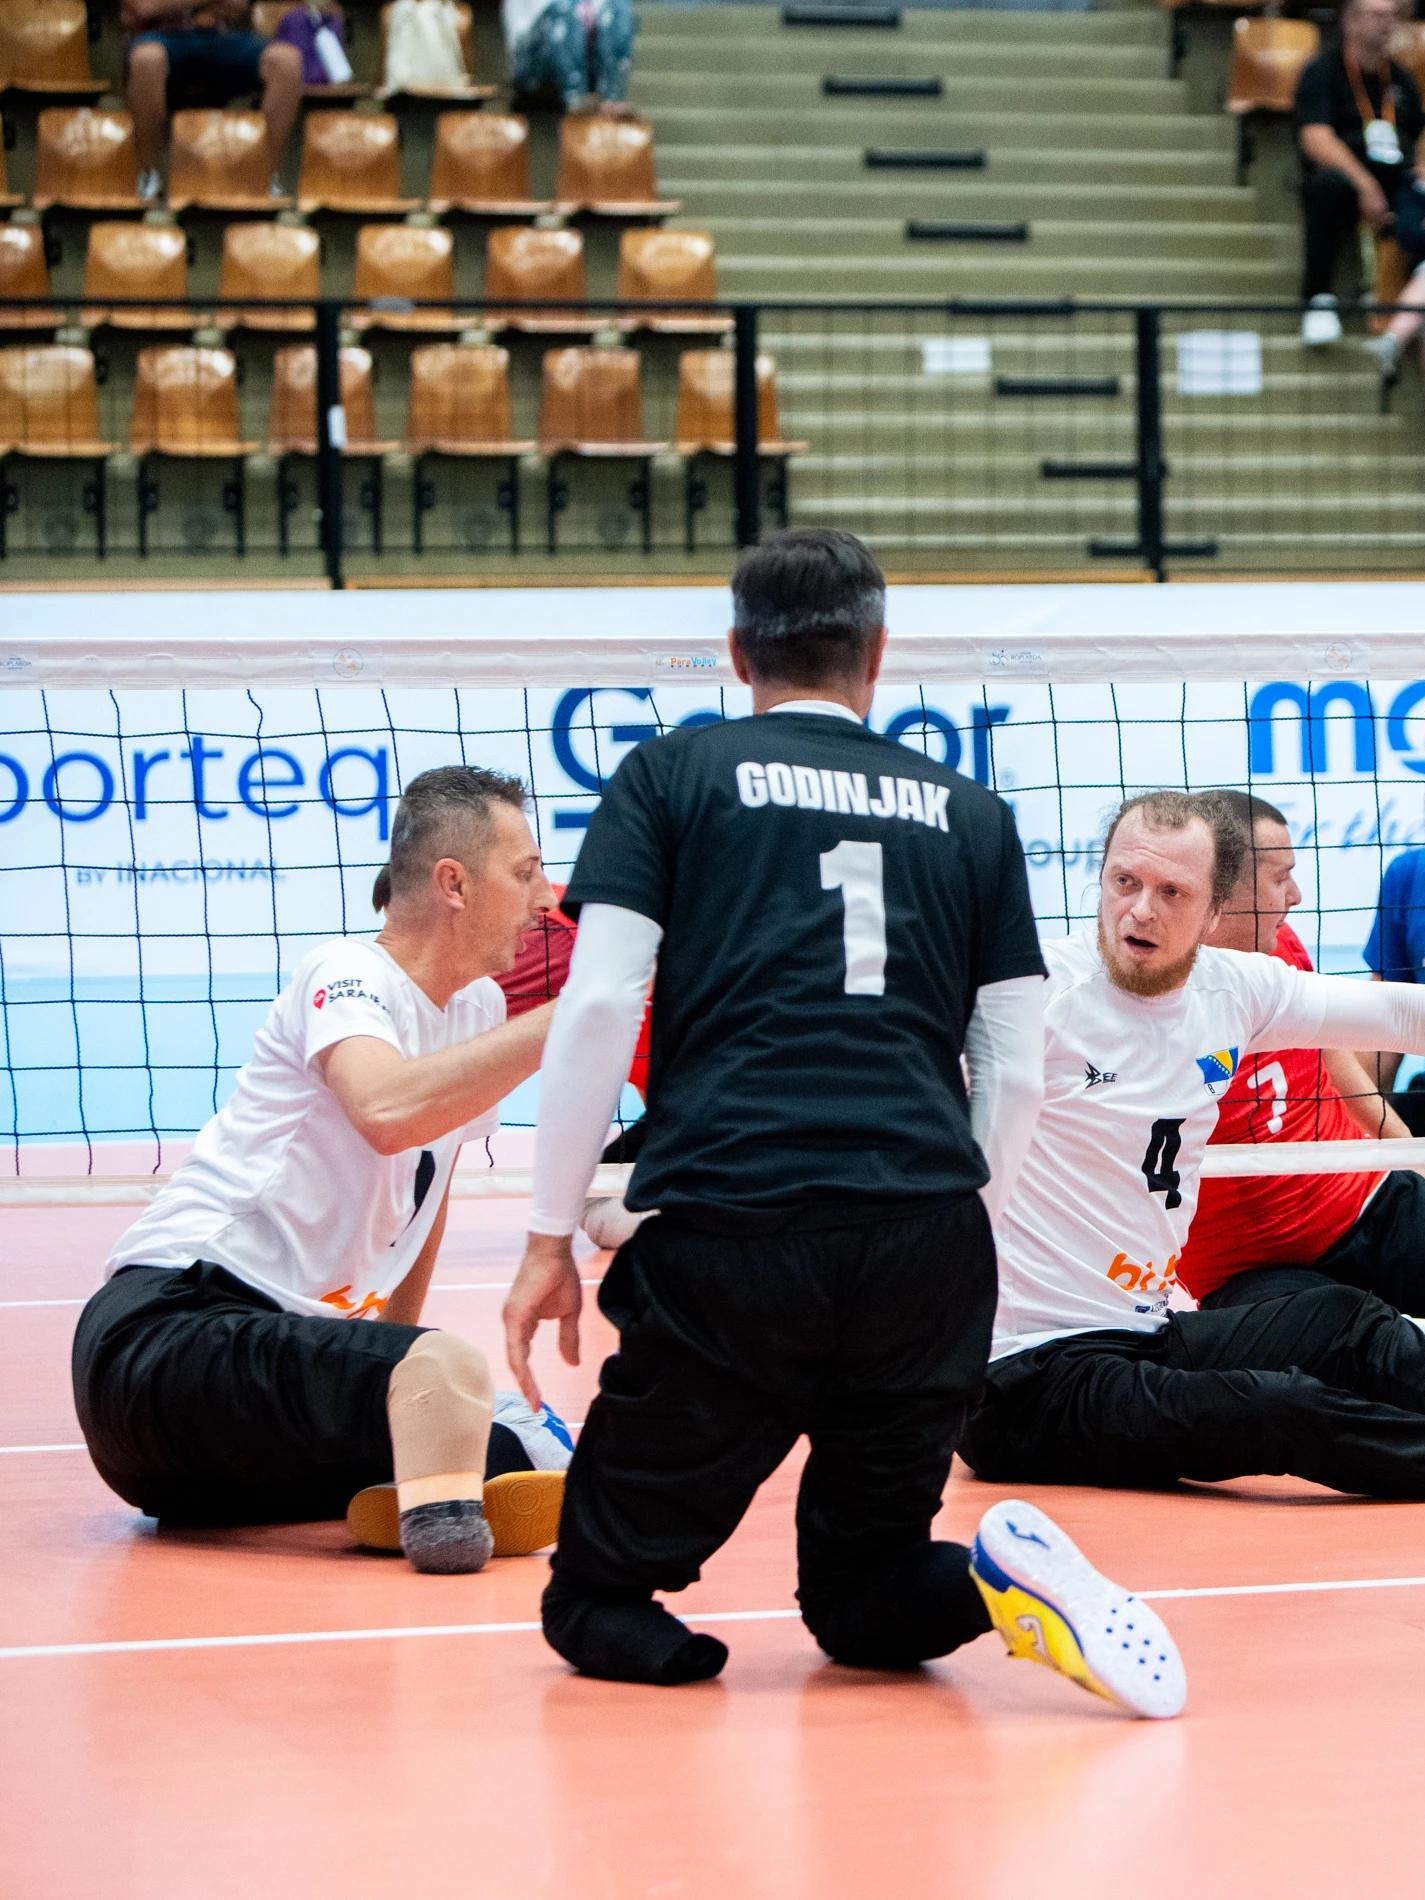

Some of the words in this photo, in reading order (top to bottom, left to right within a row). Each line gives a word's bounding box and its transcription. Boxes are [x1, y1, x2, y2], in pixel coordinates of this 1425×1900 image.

[670, 657, 716, 666] ParaVolley
[735, 760, 951, 834] GODINJAK
[819, 840, 888, 996] 1
[327, 979, 363, 991] VISIT
[1247, 1061, 1288, 1134] 7
[1141, 1118, 1187, 1210] 4
